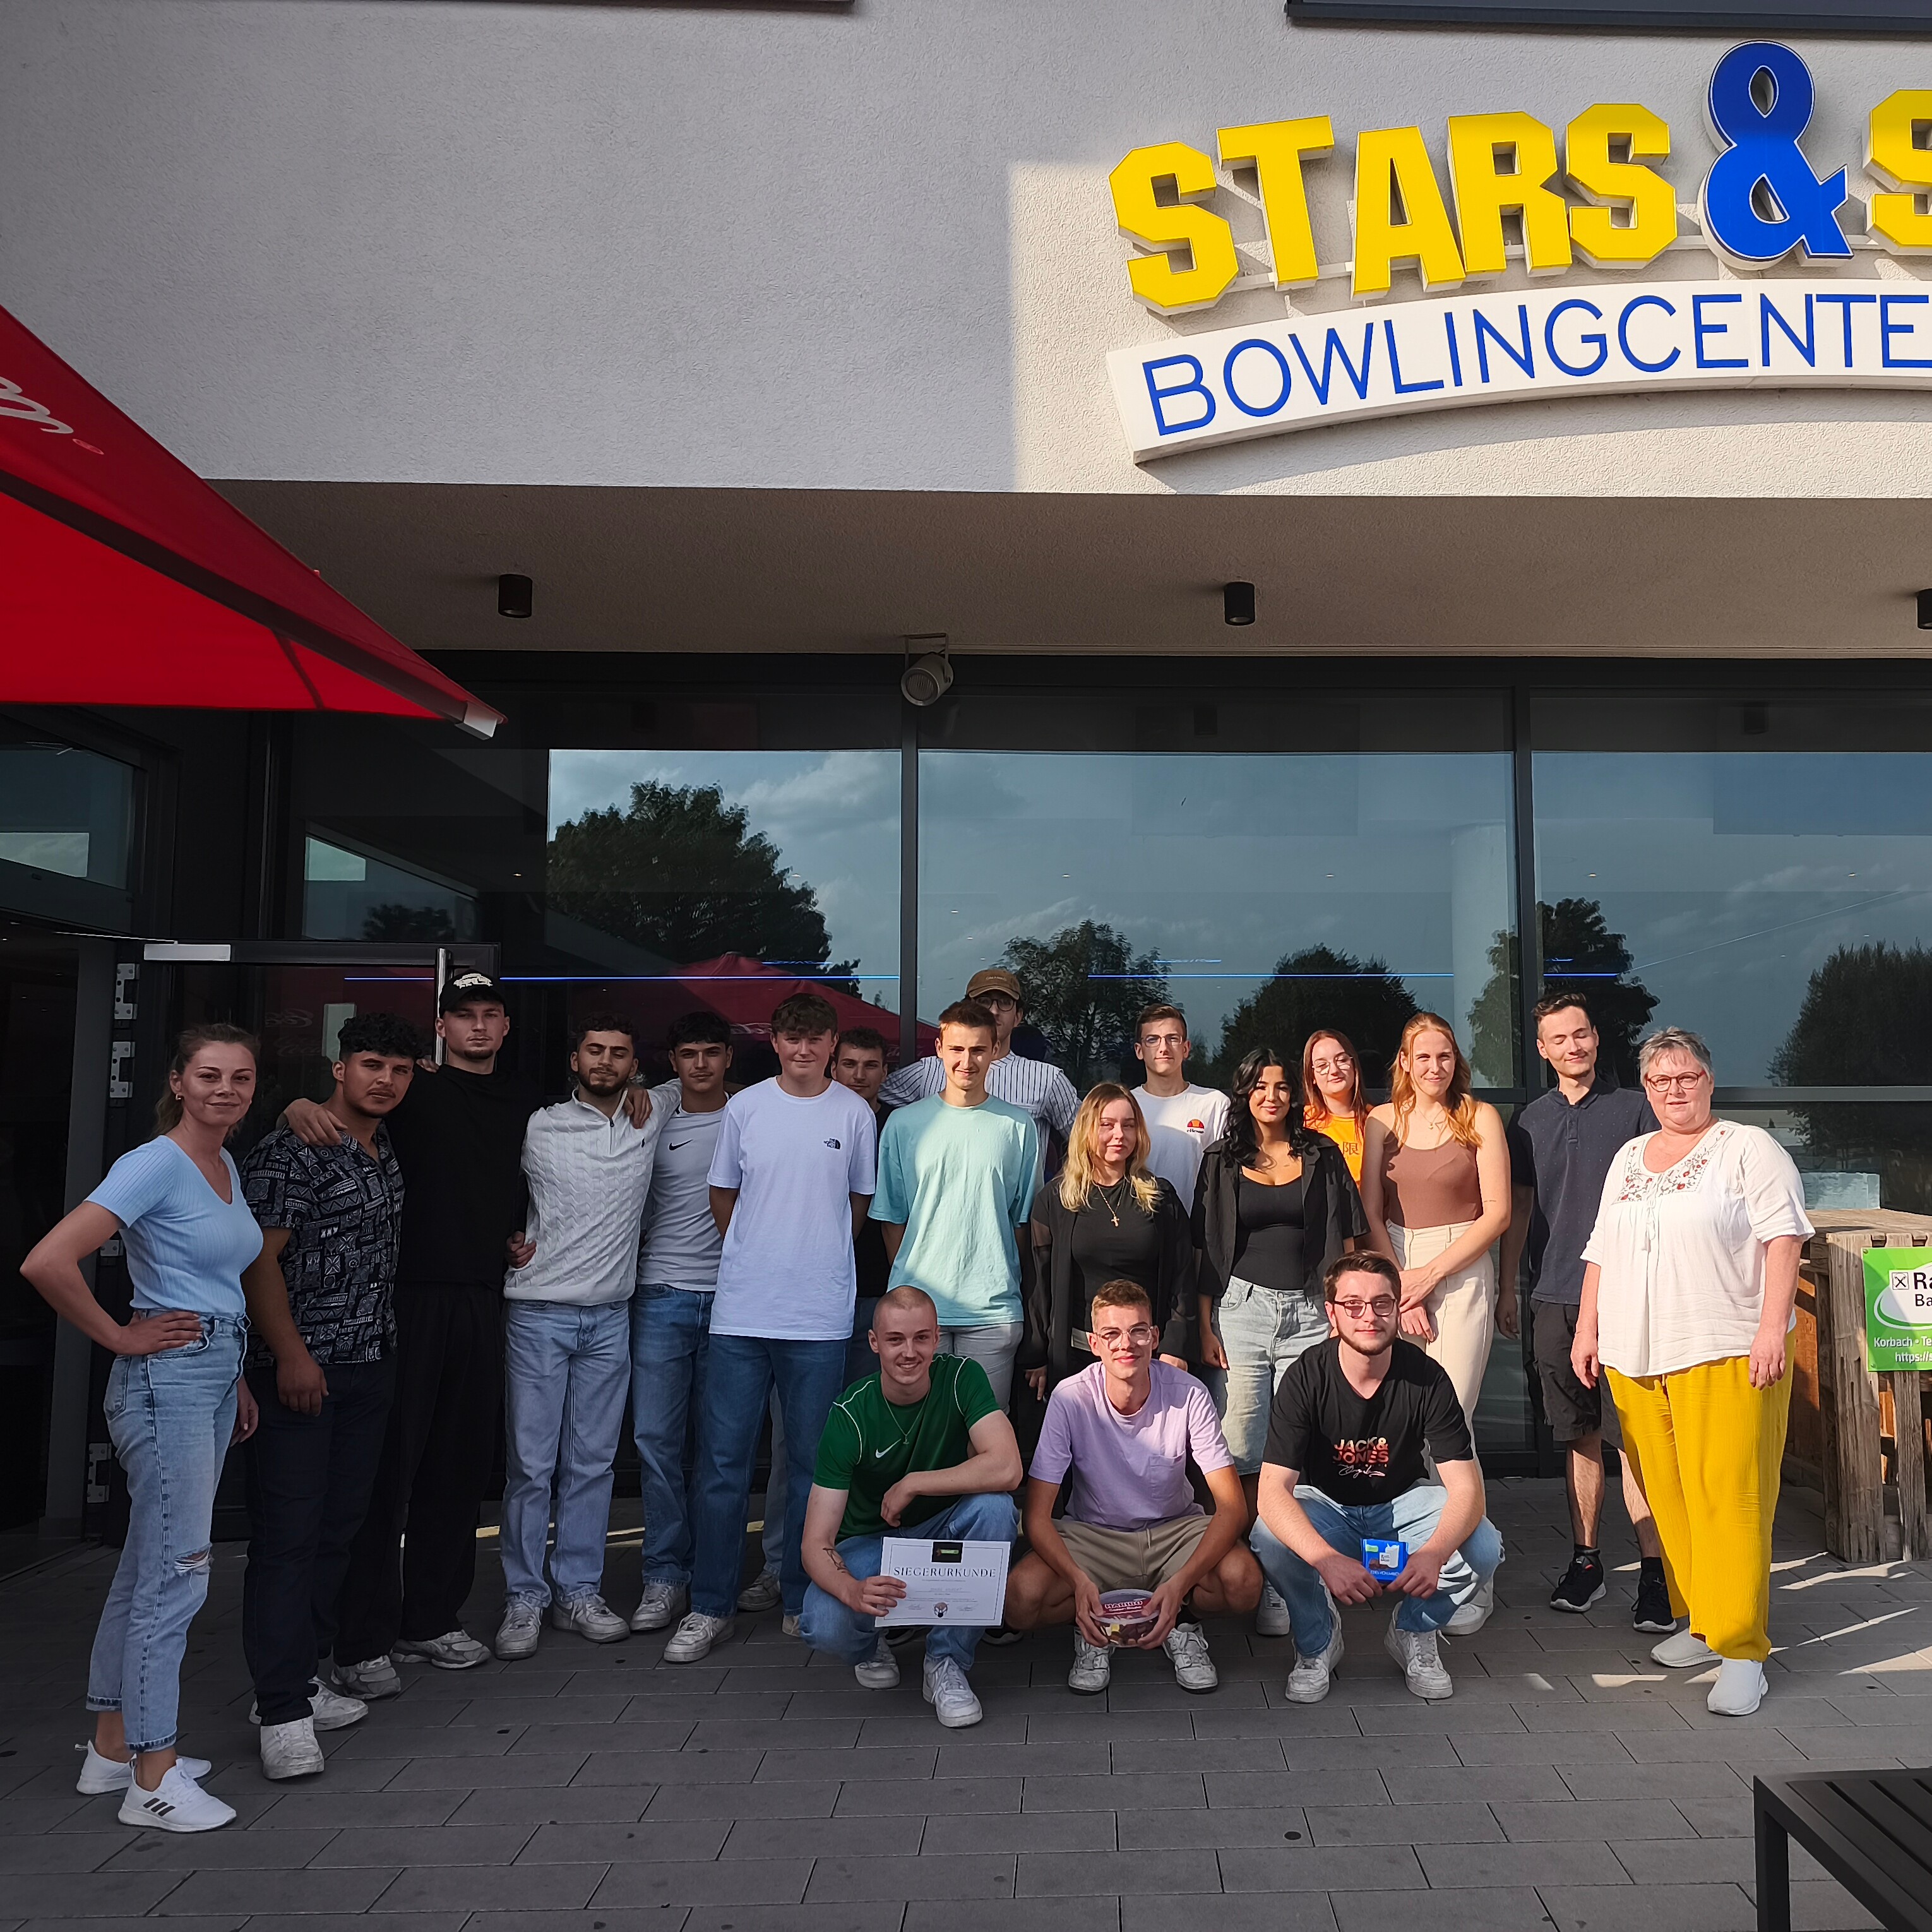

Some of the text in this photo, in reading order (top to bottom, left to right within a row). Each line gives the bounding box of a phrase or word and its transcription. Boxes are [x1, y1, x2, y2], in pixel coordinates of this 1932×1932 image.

[1108, 103, 1680, 312] STARS
[1703, 39, 1854, 260] &
[1142, 293, 1932, 437] BOWLINGCENTE
[1342, 1141, 1360, 1155] 限
[1914, 1294, 1932, 1307] Ba
[1873, 1335, 1932, 1348] Korbach Te
[1332, 1450, 1389, 1464] JONES
[893, 1566, 997, 1578] SIEGERURKUNDE
